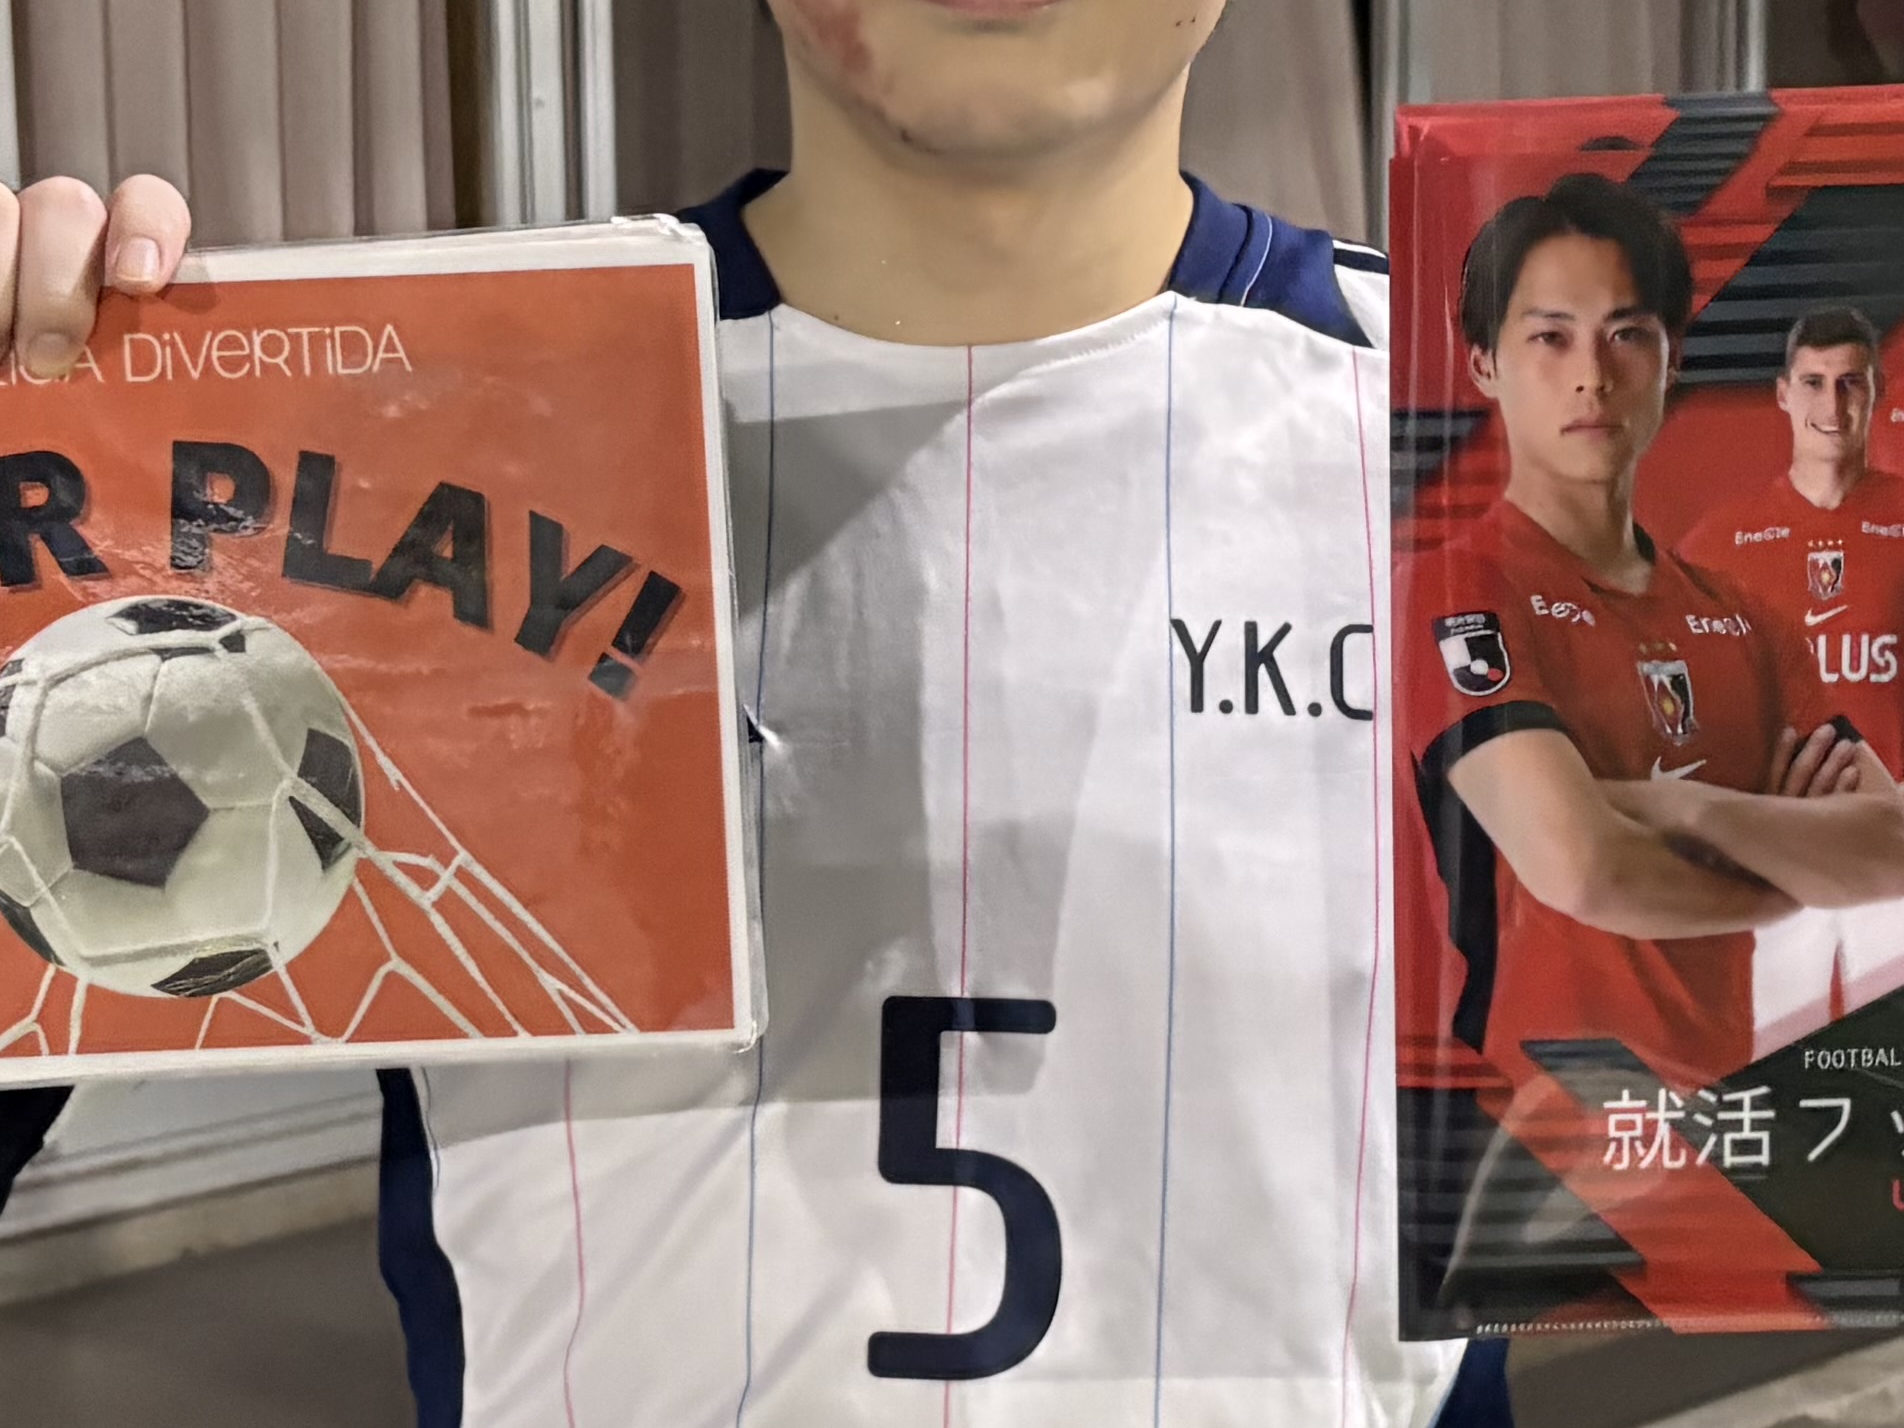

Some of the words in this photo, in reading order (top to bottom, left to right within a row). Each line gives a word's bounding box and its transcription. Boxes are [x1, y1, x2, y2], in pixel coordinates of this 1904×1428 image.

[169, 440, 683, 702] PLAY!
[1805, 633, 1898, 683] LUS
[867, 995, 1063, 1381] 5
